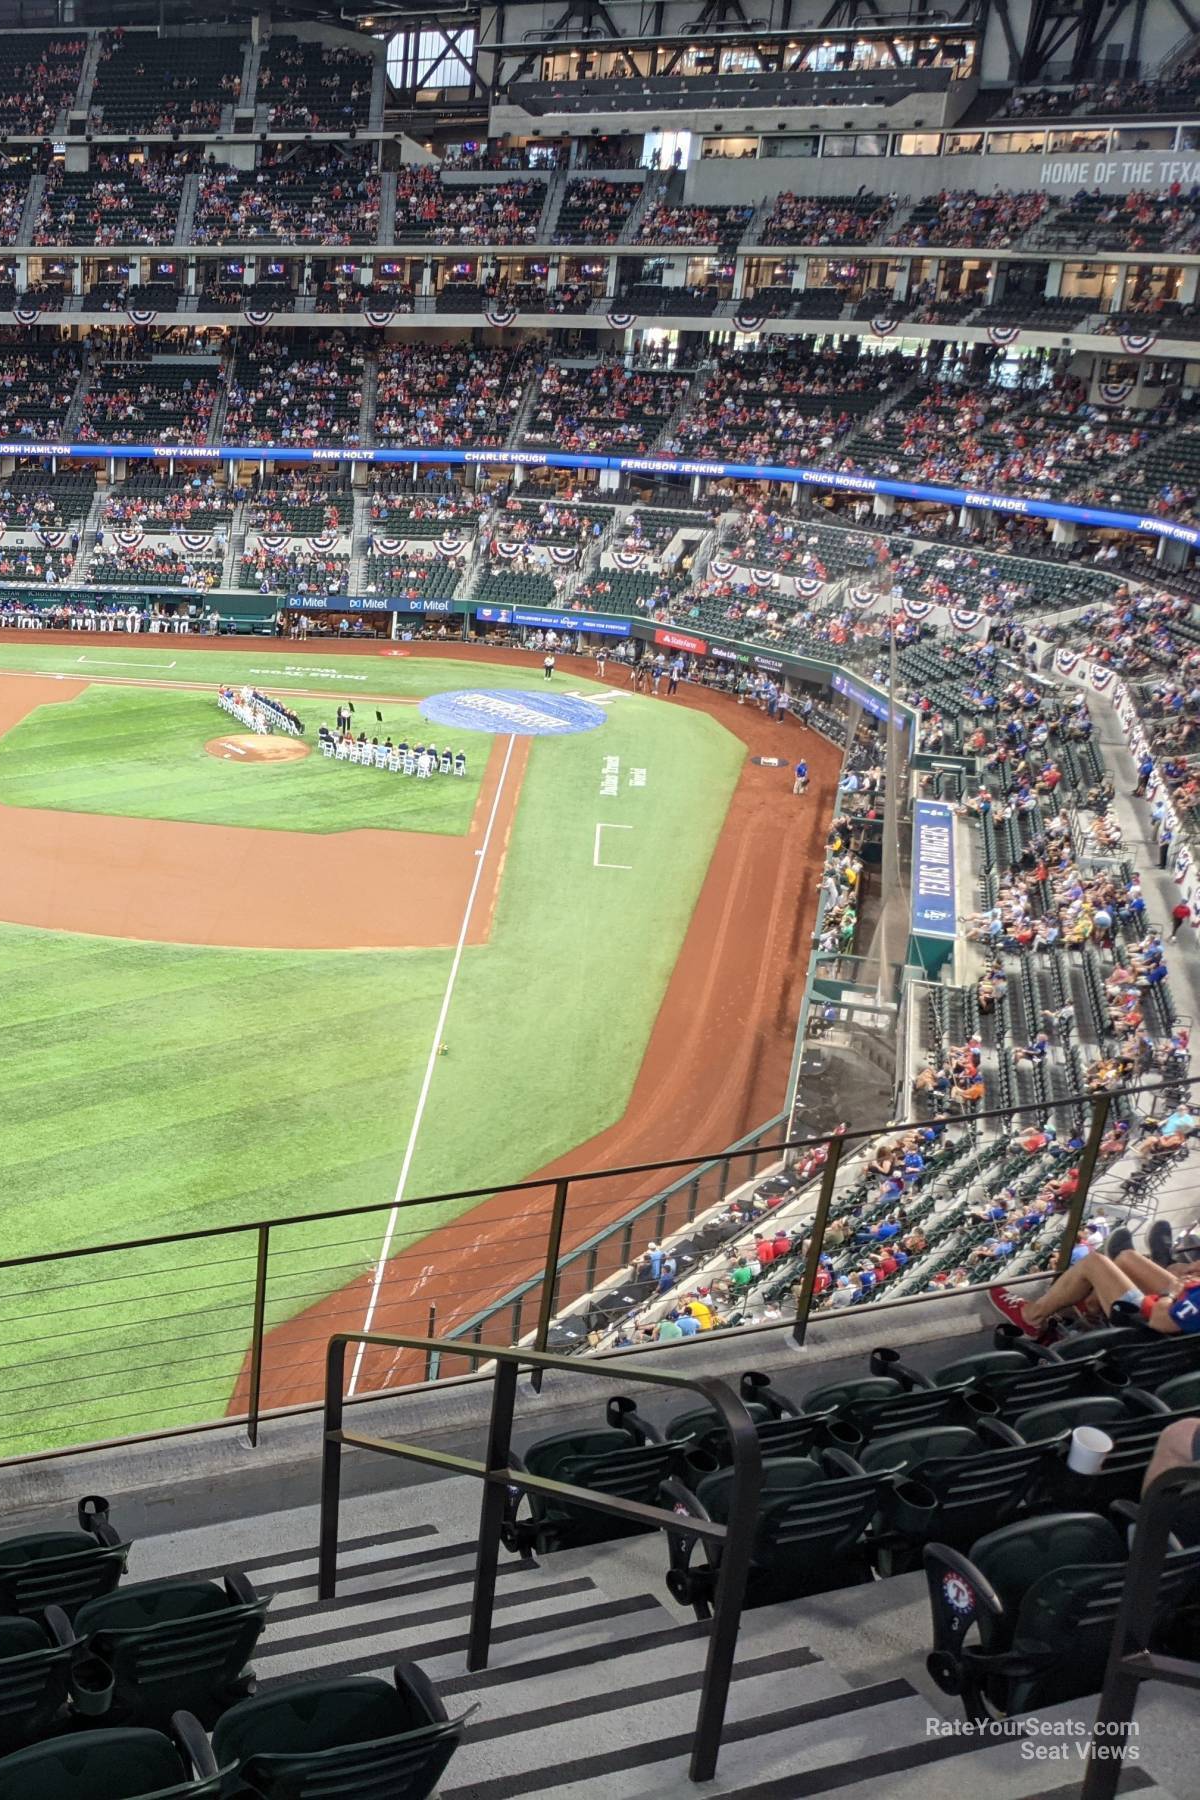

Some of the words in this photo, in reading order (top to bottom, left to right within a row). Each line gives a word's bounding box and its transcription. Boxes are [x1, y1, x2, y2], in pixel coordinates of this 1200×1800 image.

[1040, 162, 1089, 183] HOME
[1094, 162, 1117, 183] OF
[1121, 162, 1153, 183] THE
[24, 446, 71, 454] HAMILTON
[153, 448, 177, 456] TOBY
[180, 449, 220, 457] HARRAH
[313, 451, 340, 459] MARK
[343, 452, 375, 460] HOLTZ
[465, 453, 509, 461] CHARLIE
[511, 455, 547, 463] HOUGH
[621, 460, 677, 471] FERGUSON
[679, 464, 725, 474] JENKINS
[803, 472, 833, 484] CHUCK
[835, 477, 876, 489] MORGAN
[965, 495, 990, 506] ERIC
[991, 499, 1029, 512] NADEL
[302, 598, 327, 607] Mitel
[362, 599, 387, 609] Mitel
[423, 600, 448, 610] Mitel
[712, 647, 727, 656] Globe
[727, 651, 737, 660] Life
[737, 654, 750, 662] Field
[920, 825, 949, 864] RANGERS
[919, 864, 950, 896] TEXAS
[1176, 1299, 1198, 1318] T
